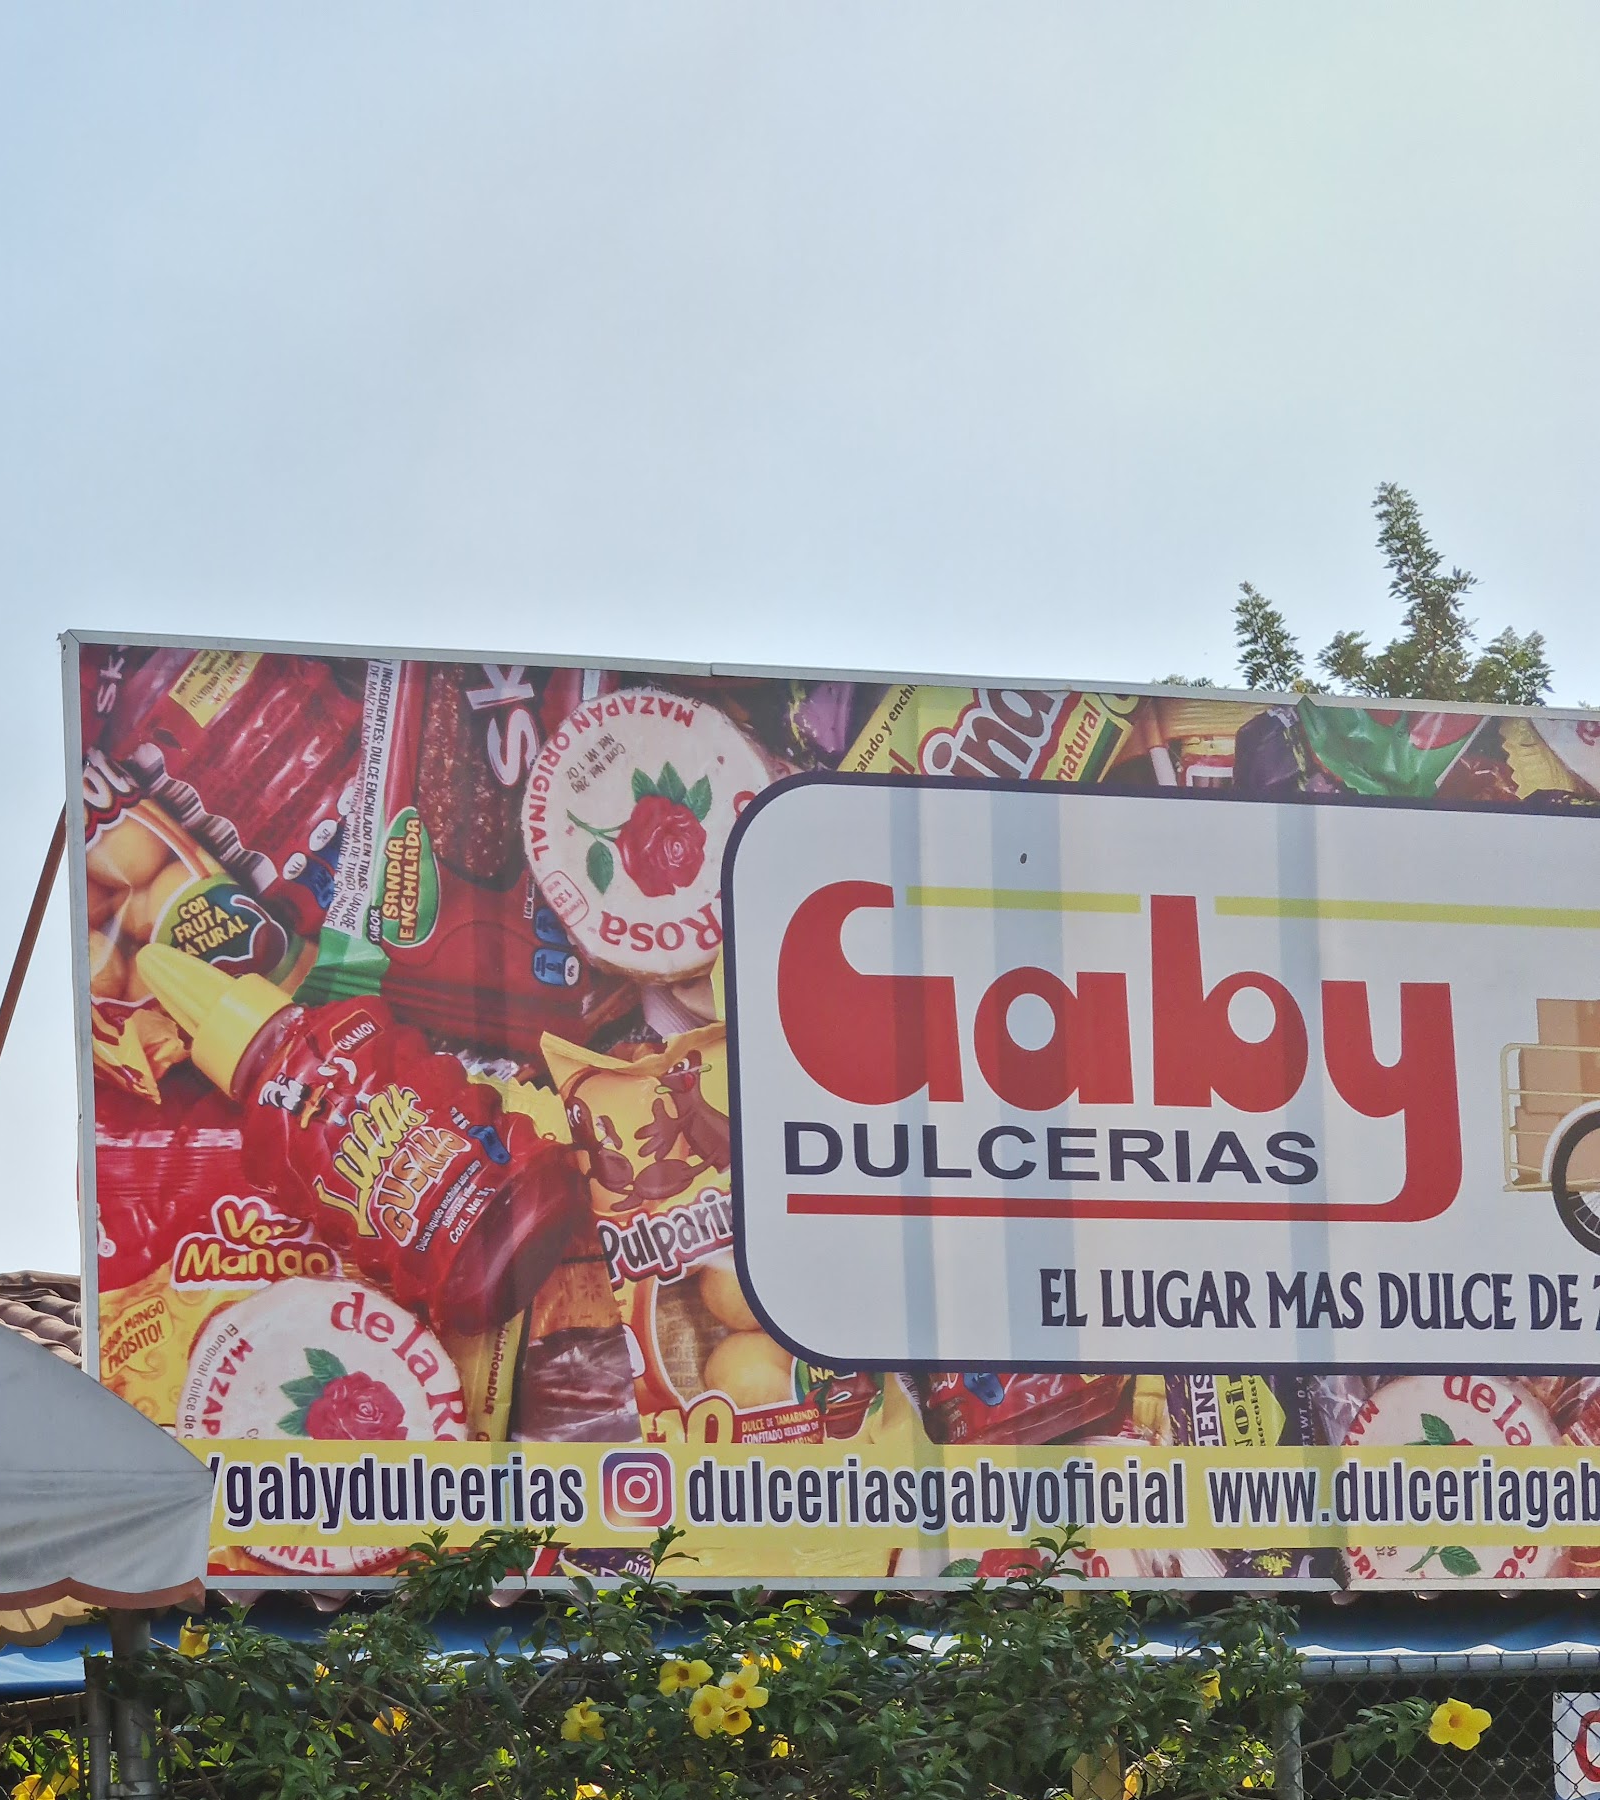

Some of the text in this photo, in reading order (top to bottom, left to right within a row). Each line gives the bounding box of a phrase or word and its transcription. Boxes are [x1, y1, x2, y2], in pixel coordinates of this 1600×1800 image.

[528, 734, 571, 862] ORIGINAL
[383, 836, 404, 919] SANDÍA
[398, 818, 421, 940] ENCHILADA
[173, 906, 230, 943] FRUTA
[178, 916, 249, 957] ATURAL
[599, 903, 723, 951] Rosa
[777, 880, 1463, 1222] Gaby
[377, 1127, 469, 1245] GUSANO
[784, 1121, 1320, 1185] DULCERIAS
[179, 1242, 330, 1278] Mango
[1040, 1268, 1583, 1332] EL LUGAR MAS DULCE DE
[330, 1291, 395, 1343] de
[393, 1320, 439, 1387] la
[689, 1457, 1185, 1532] dulceriasgabyoficial
